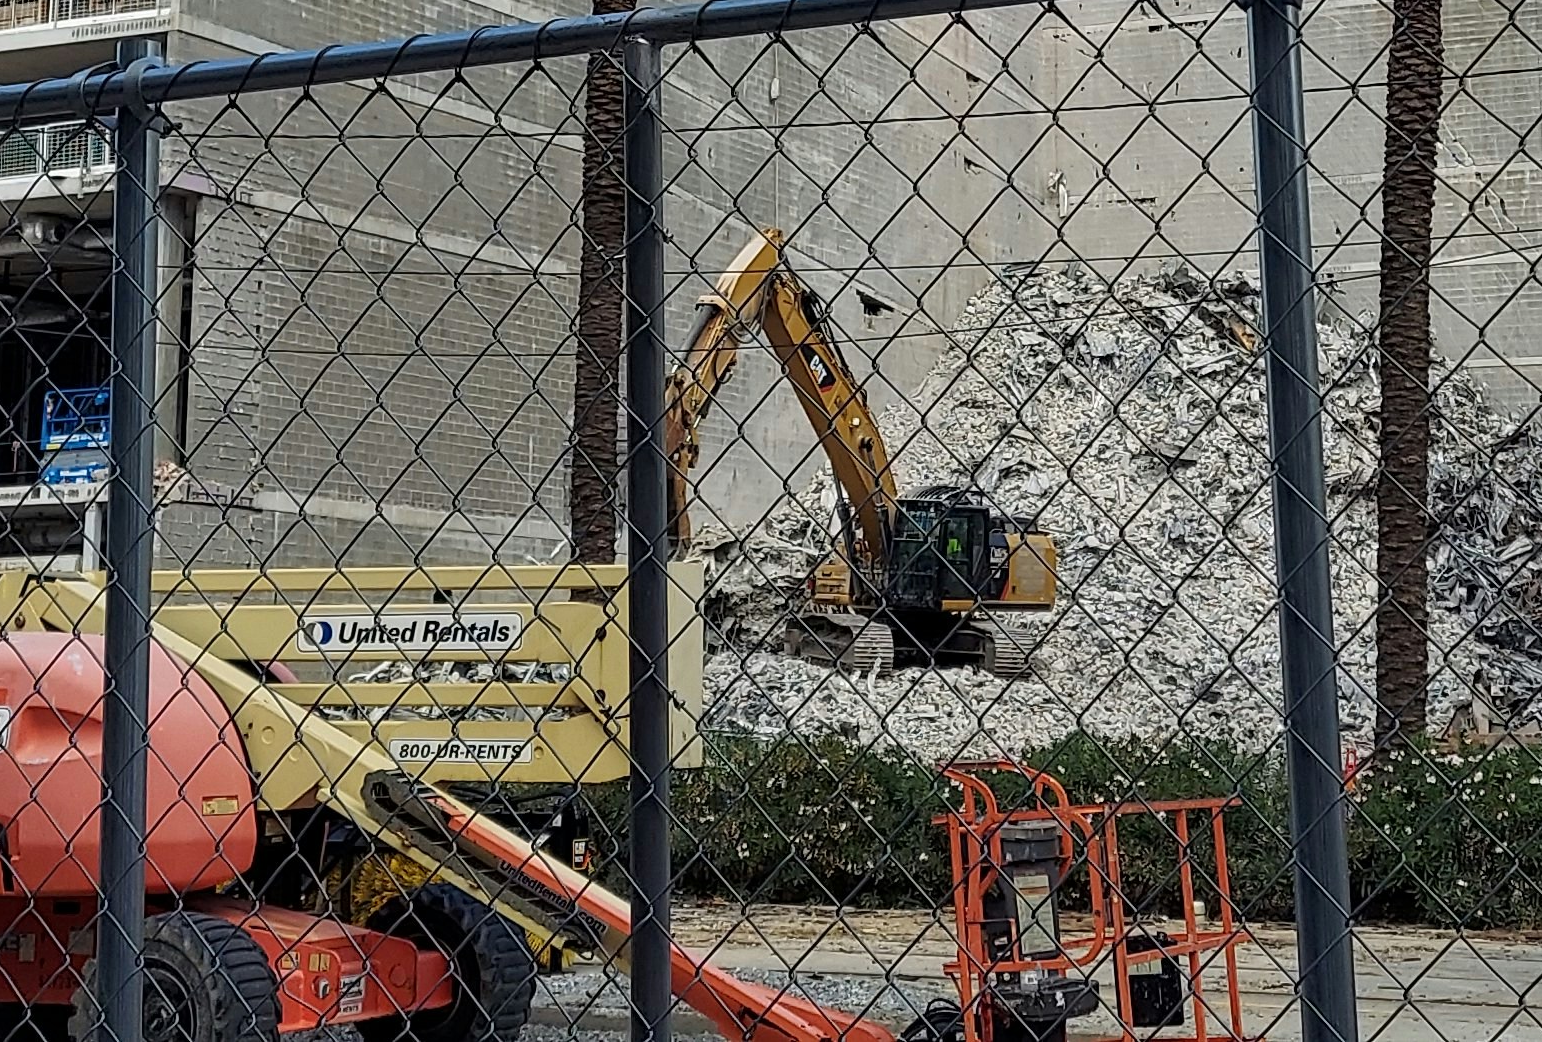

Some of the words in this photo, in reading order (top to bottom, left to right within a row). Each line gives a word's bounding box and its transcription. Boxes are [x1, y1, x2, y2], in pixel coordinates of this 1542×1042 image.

[810, 354, 828, 385] CAT
[339, 621, 416, 644] United
[422, 620, 511, 643] Rentals
